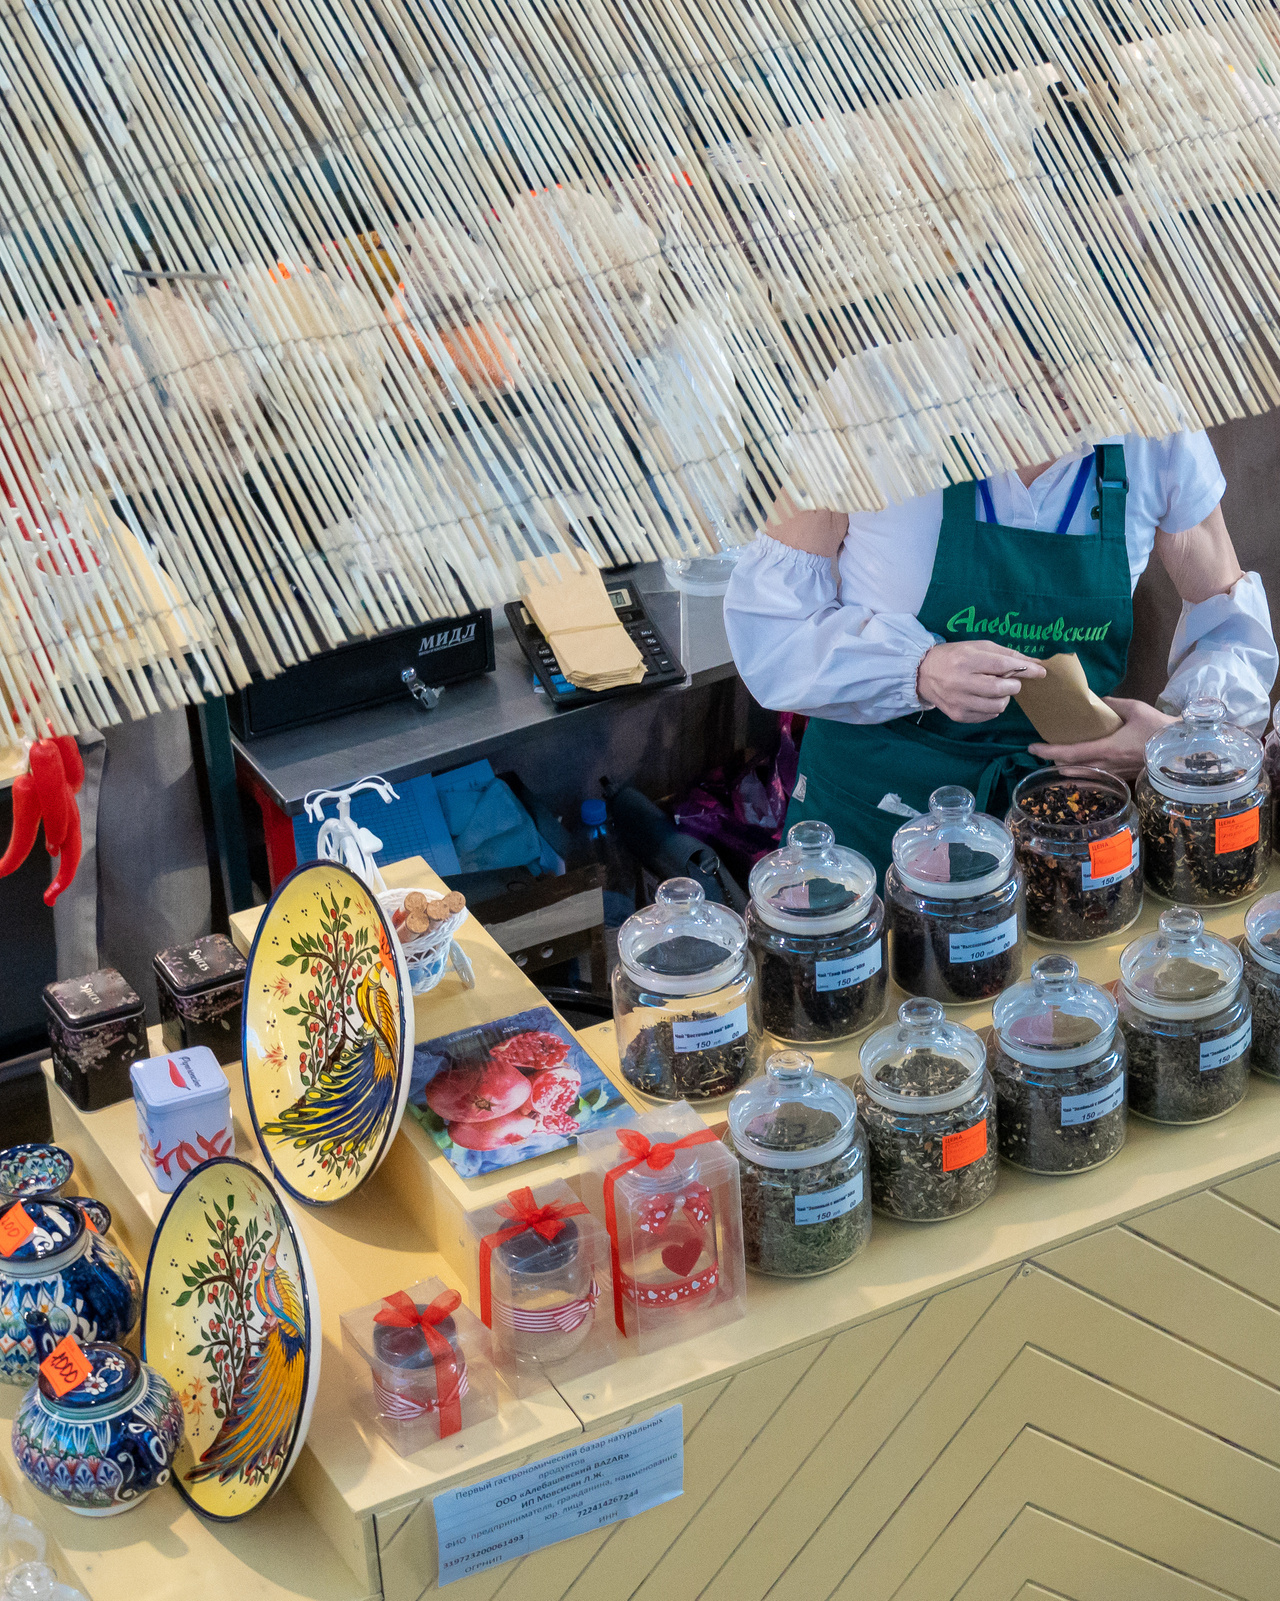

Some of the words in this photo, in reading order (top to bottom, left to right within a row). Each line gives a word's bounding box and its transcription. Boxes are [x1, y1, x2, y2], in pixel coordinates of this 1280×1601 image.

[946, 605, 1112, 642] Алебашевский
[418, 622, 477, 652] МИДЛ
[188, 949, 211, 972] Spices
[970, 950, 985, 959] 100
[80, 982, 102, 1005] Spices
[837, 978, 852, 987] 150
[696, 1040, 711, 1049] 150
[1082, 1111, 1096, 1121] 150
[816, 1211, 831, 1220] 150
[455, 1481, 492, 1500] Первый
[493, 1449, 578, 1487] гастрономический
[579, 1440, 606, 1454] базар
[608, 1418, 663, 1443] натуральных
[538, 1458, 586, 1480] продуктов
[495, 1494, 517, 1508] ООО
[519, 1464, 592, 1498] «Алебашевский
[594, 1452, 630, 1469] BAZAR»
[444, 1536, 467, 1549] ФИО
[470, 1503, 555, 1541] предпринимателя,
[556, 1480, 613, 1505] гражданина,
[614, 1452, 678, 1482] наименование
[521, 1498, 535, 1509] ИП
[537, 1480, 582, 1503] Мовсисян
[576, 1488, 639, 1518] 722414267244
[544, 1510, 560, 1521] юр.
[562, 1500, 584, 1514] лица
[598, 1510, 618, 1523] ИНН
[464, 1554, 502, 1574] ОГРНИП
